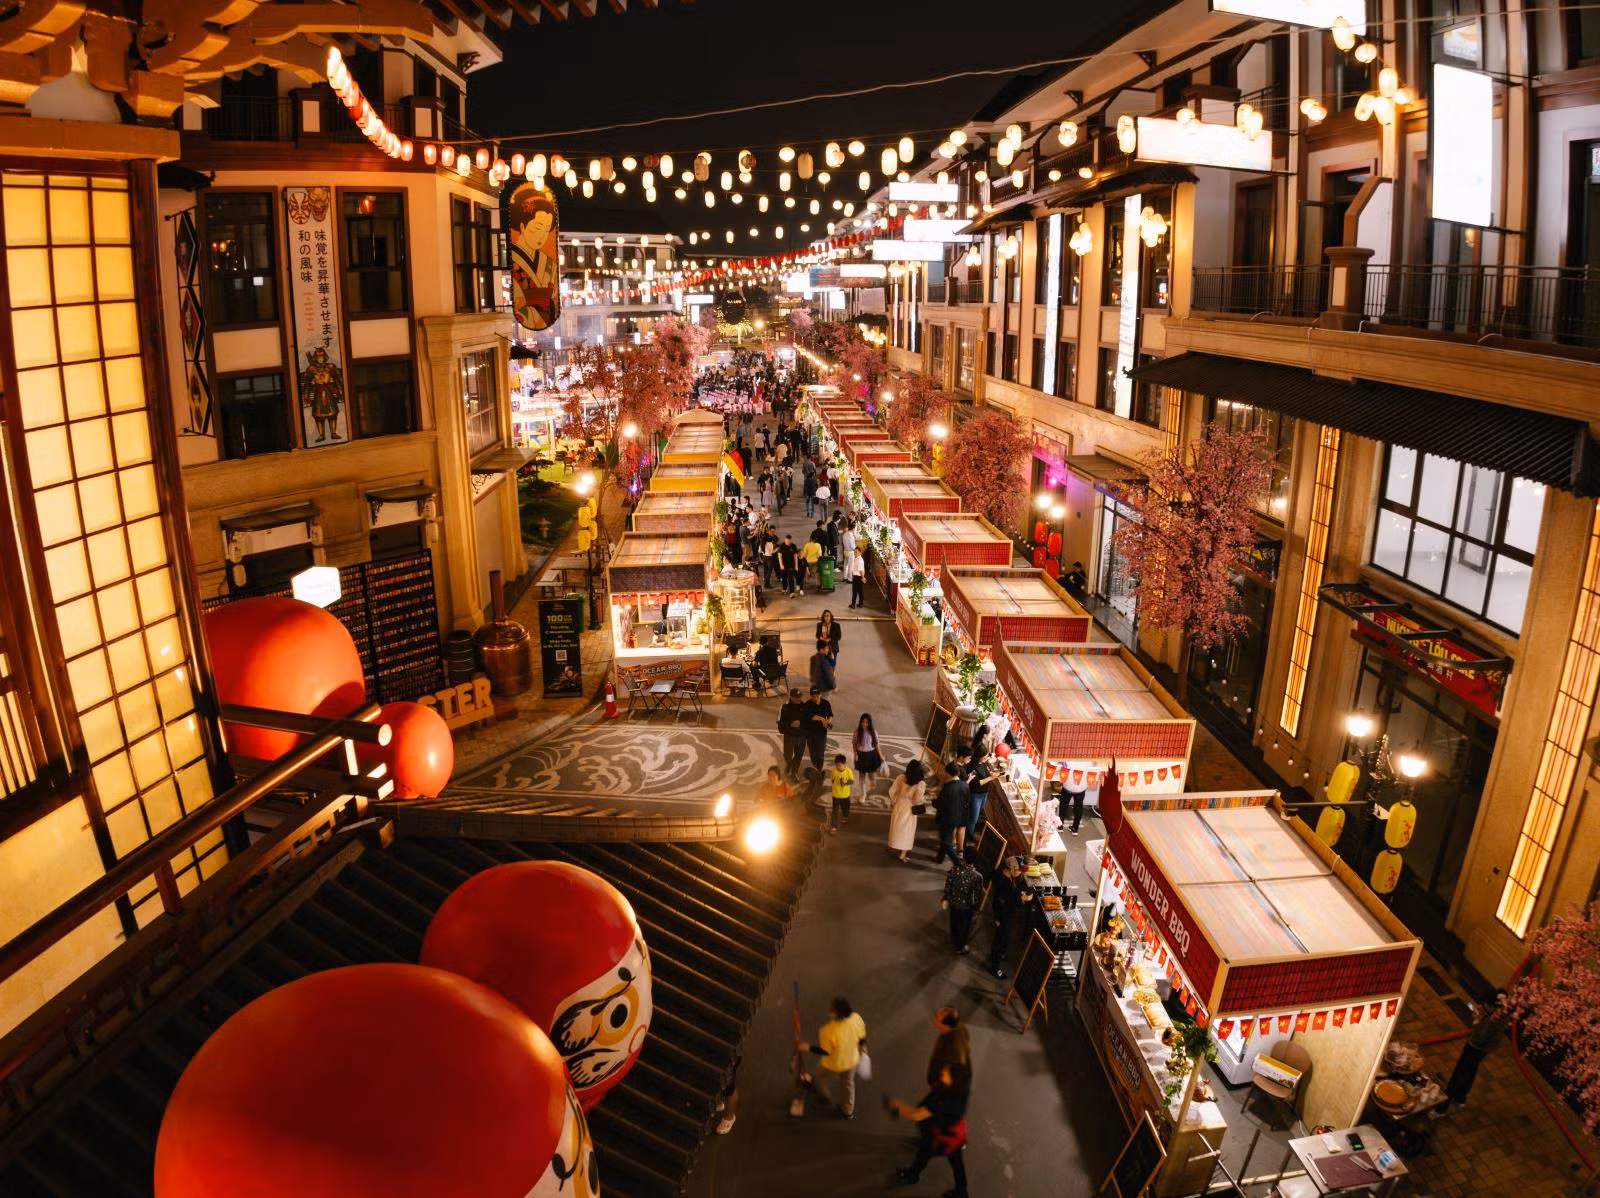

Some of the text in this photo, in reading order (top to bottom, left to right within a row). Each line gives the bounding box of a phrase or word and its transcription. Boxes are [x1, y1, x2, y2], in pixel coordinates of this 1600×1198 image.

[298, 230, 313, 283] 和の風味
[314, 229, 333, 349] 味覚を昇華させます
[546, 614, 564, 622] 100
[642, 665, 666, 674] OCEAN
[667, 663, 682, 671] BBQ
[1131, 848, 1191, 958] WONDER BBQ
[1108, 1023, 1128, 1062] OCEAN
[1127, 1060, 1141, 1090] BBQ
